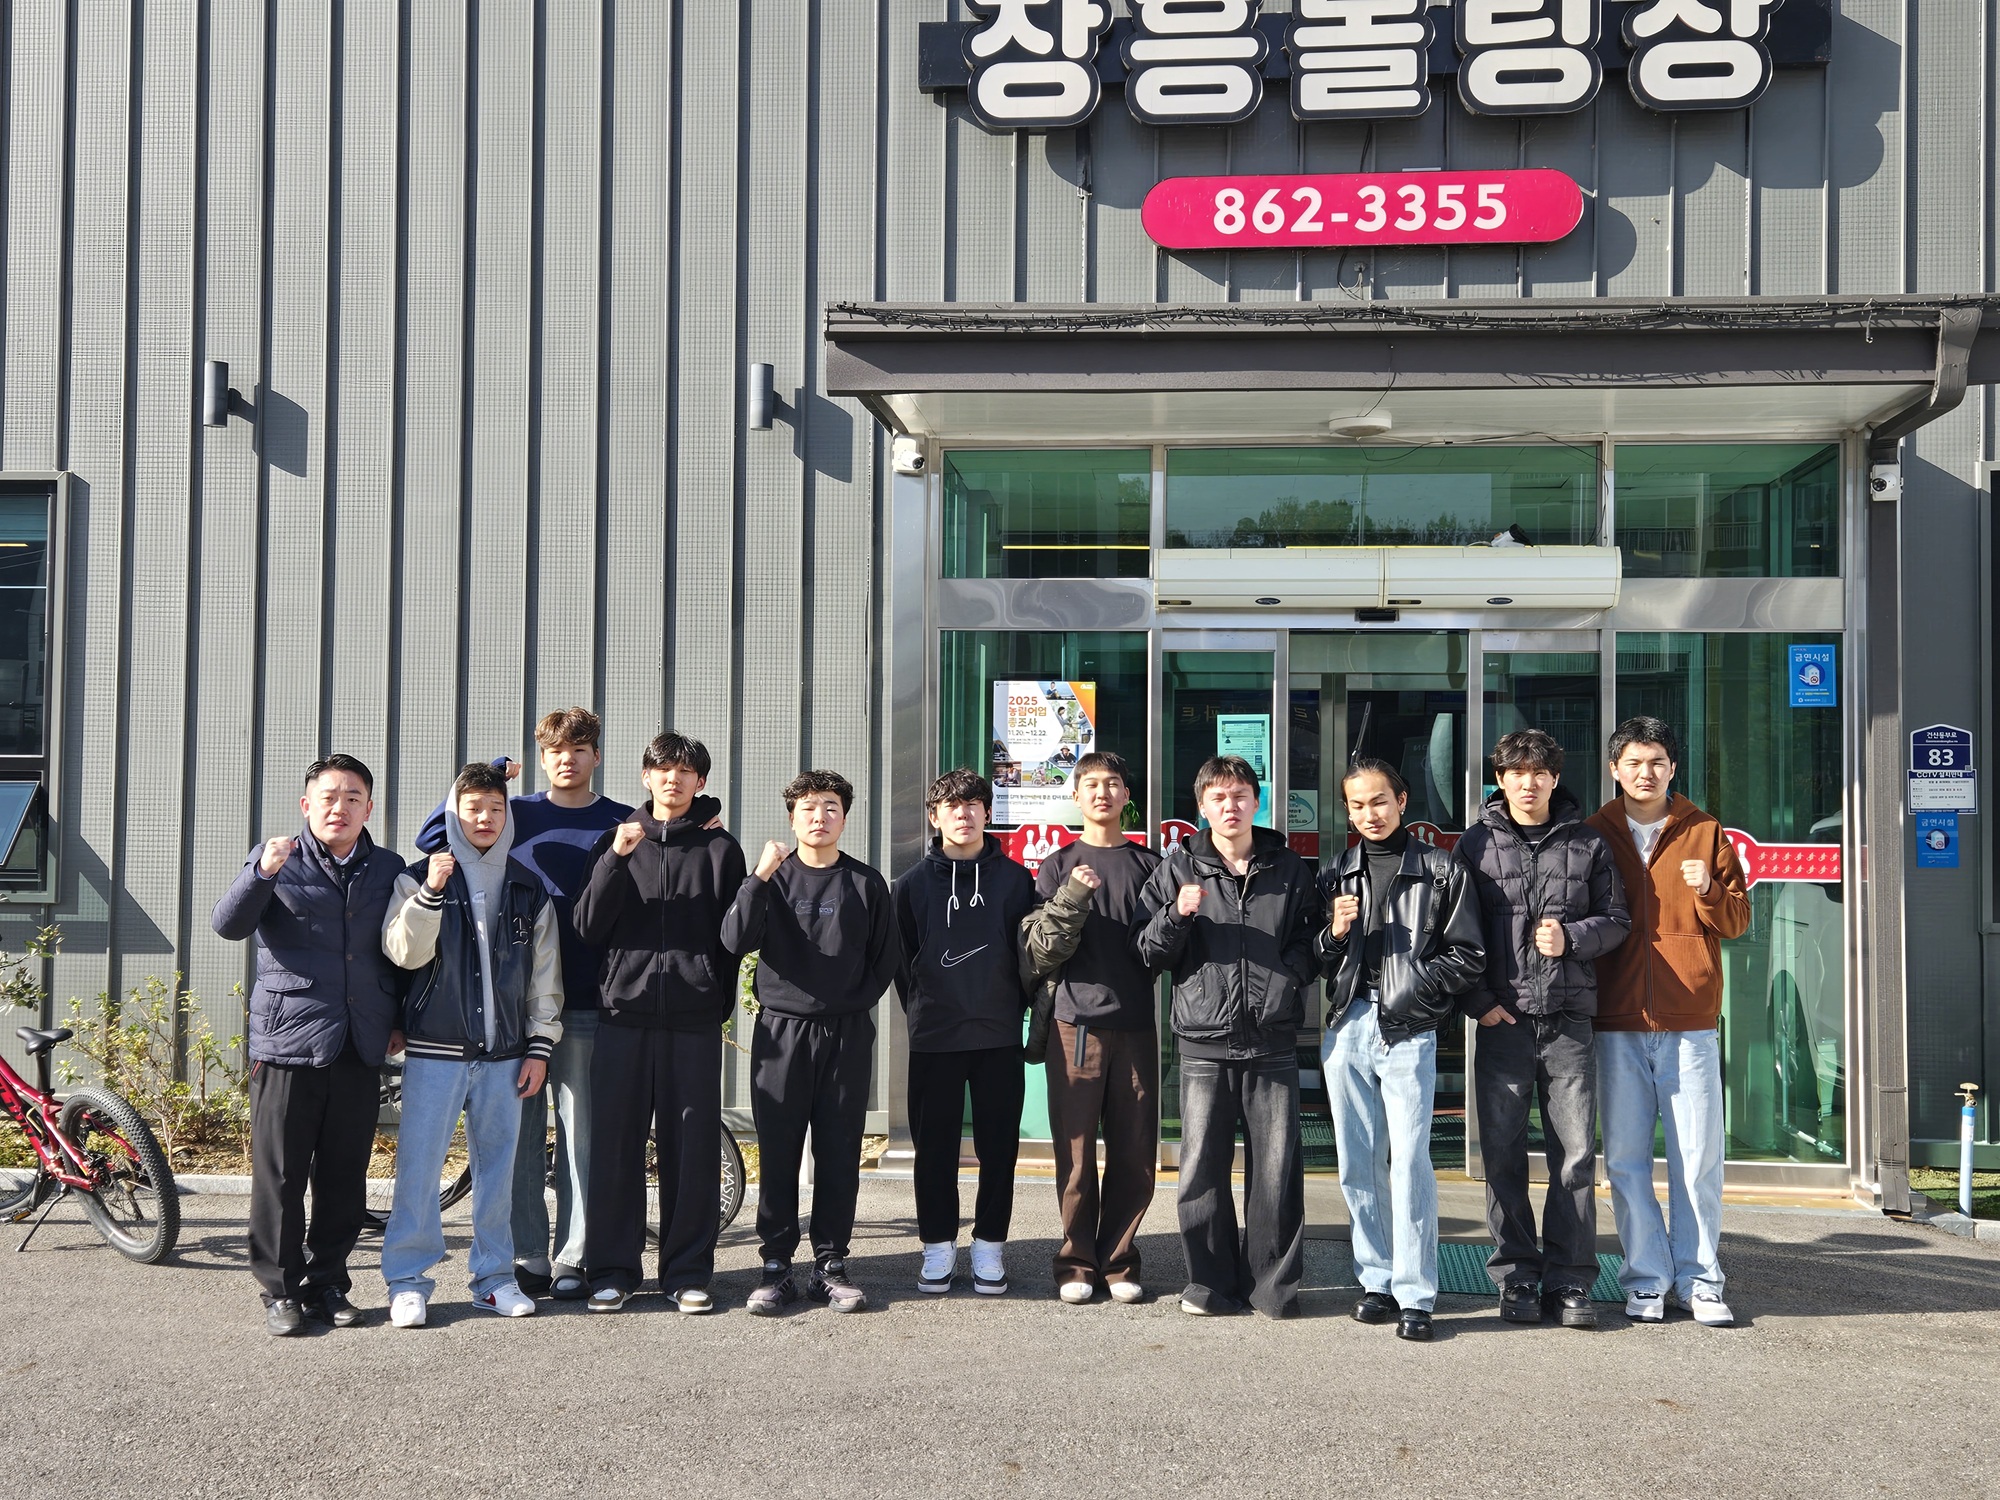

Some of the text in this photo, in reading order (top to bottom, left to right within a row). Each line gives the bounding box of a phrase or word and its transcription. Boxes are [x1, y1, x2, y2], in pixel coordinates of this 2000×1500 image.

[1213, 183, 1507, 235] 862-3355
[1795, 653, 1830, 662] 금연시설
[1008, 696, 1038, 706] 2025
[1008, 706, 1047, 717] 농림어업
[1008, 717, 1037, 728] 총조사
[1928, 748, 1954, 766] 83
[1921, 818, 1955, 827] 금연시설
